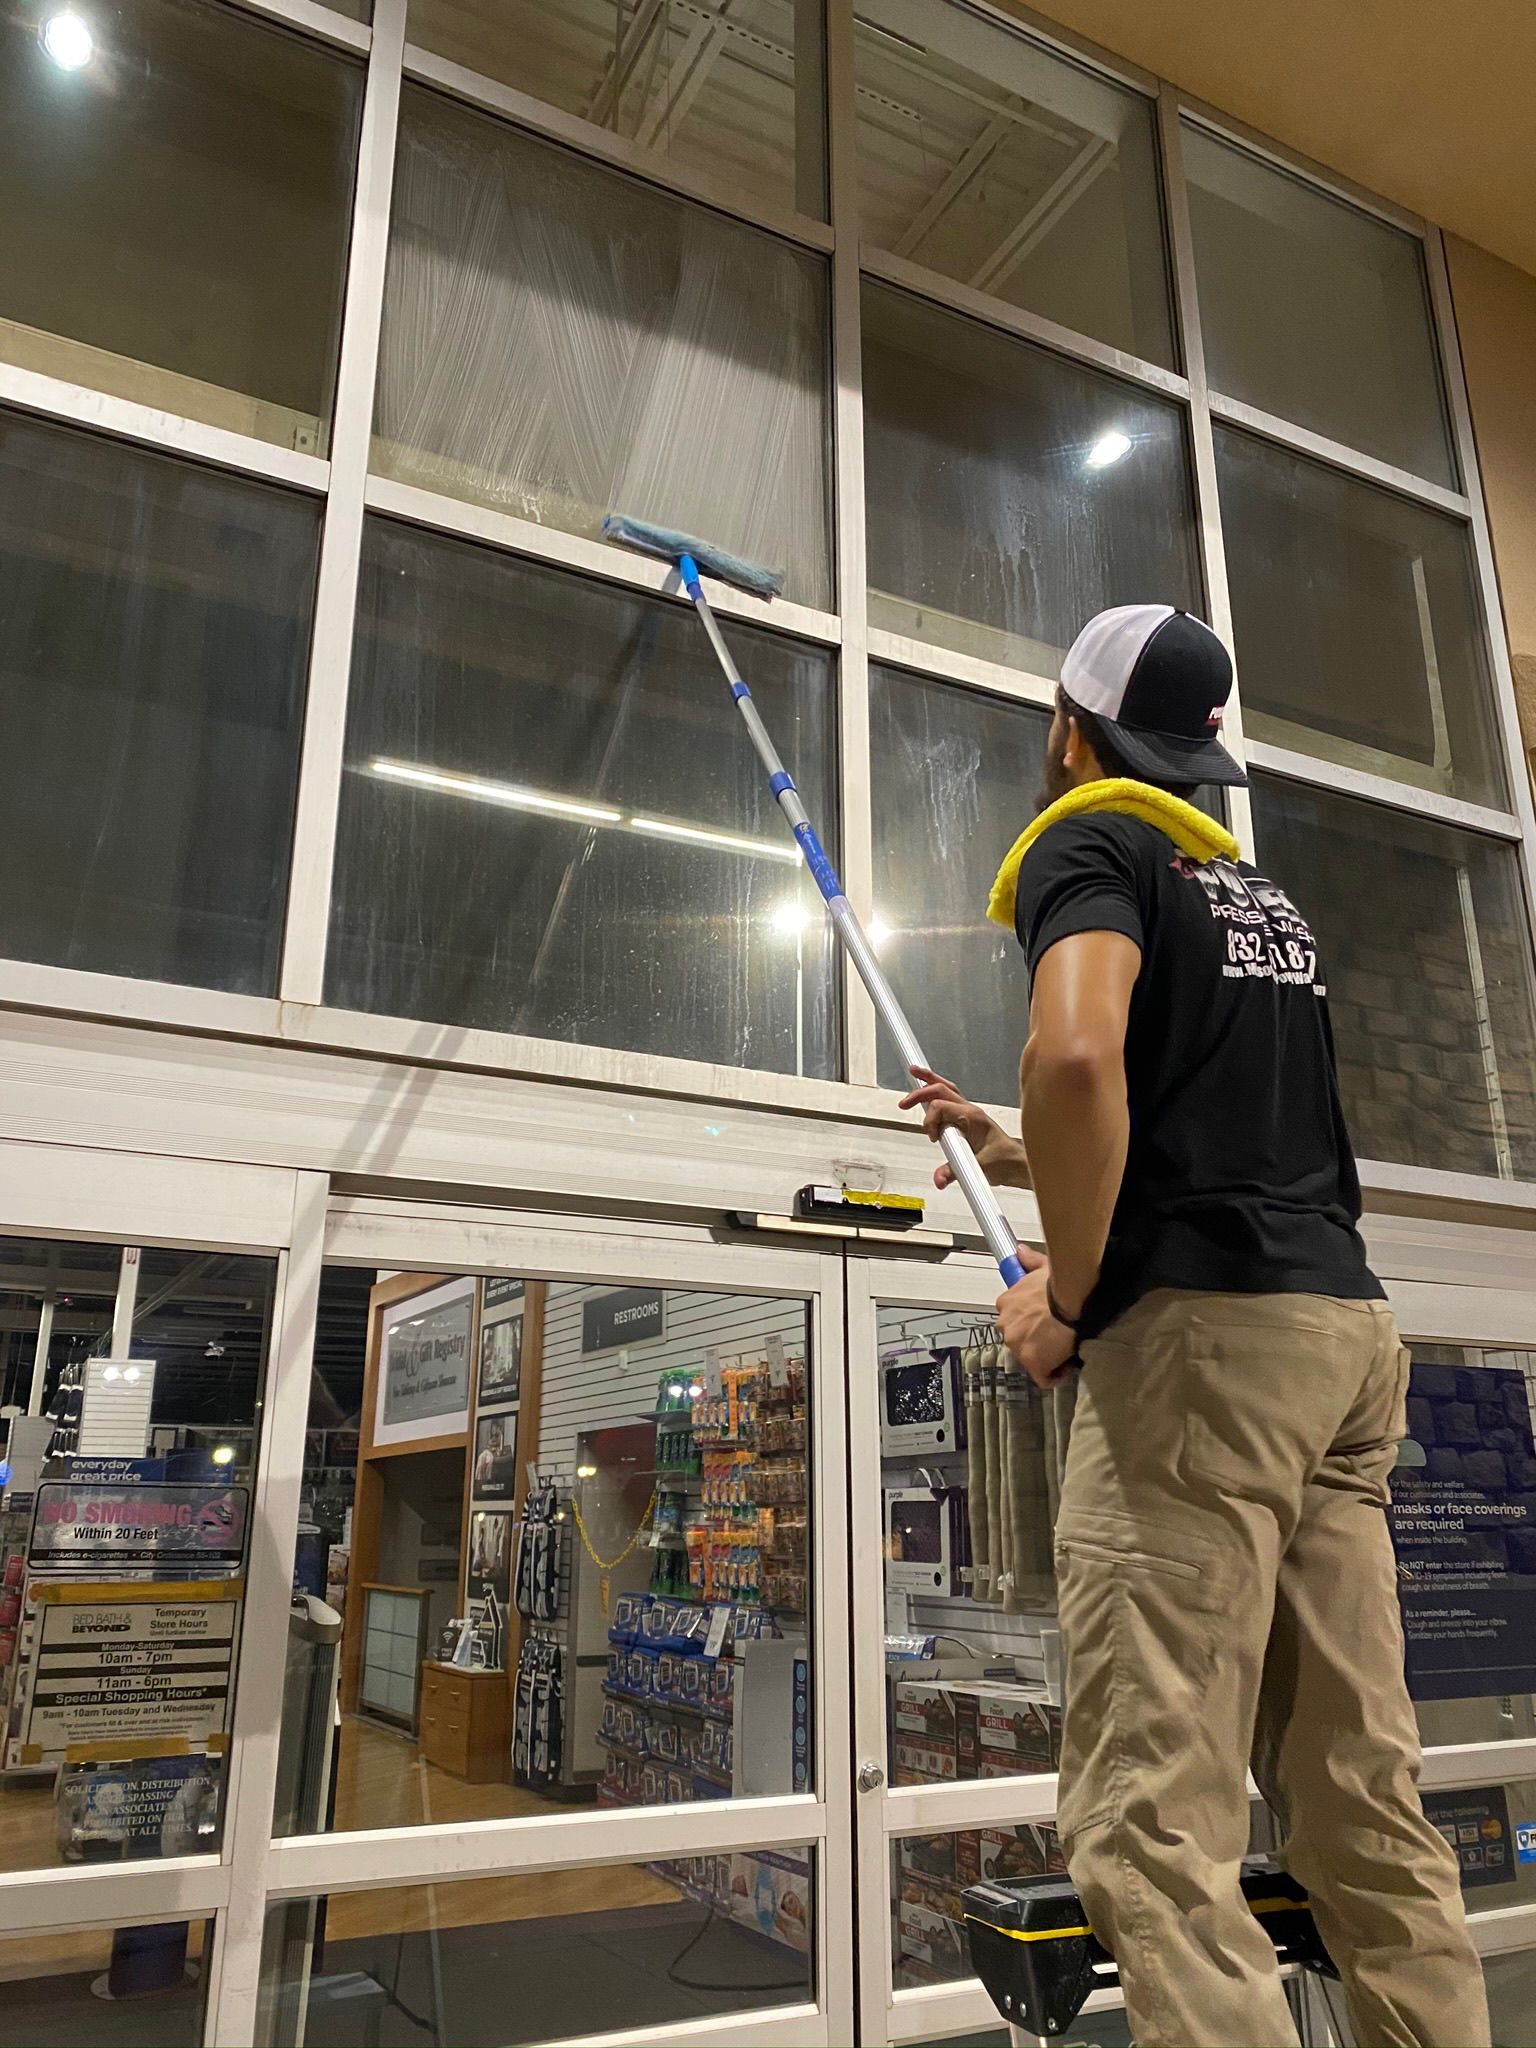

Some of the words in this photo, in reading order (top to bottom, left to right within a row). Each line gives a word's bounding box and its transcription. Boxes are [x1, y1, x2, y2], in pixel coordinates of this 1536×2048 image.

[1227, 928, 1266, 962] 832
[614, 1301, 659, 1325] RESTROOMS
[434, 1333, 466, 1362] Registry
[71, 1460, 132, 1471] everyday
[70, 1471, 108, 1481] great
[108, 1471, 141, 1481] price
[43, 1500, 78, 1524] NO
[85, 1502, 192, 1527] SMOKING
[1393, 1502, 1432, 1514] masks
[1433, 1505, 1445, 1514] or
[1447, 1502, 1472, 1515] face
[1474, 1502, 1527, 1518] coverings
[1395, 1519, 1414, 1530] are
[1416, 1518, 1464, 1532] required
[74, 1527, 112, 1540] Within
[115, 1527, 130, 1540] 20
[133, 1527, 158, 1540] Feet
[48, 1551, 81, 1559] Includes
[1409, 1560, 1425, 1569] NOT
[1425, 1560, 1442, 1569] enter
[72, 1613, 94, 1625] BED
[96, 1612, 122, 1624] BATH
[123, 1612, 132, 1624] &
[155, 1608, 206, 1618] Temporary
[71, 1624, 131, 1633] BEYOND
[150, 1620, 176, 1629] Store
[179, 1619, 208, 1629] Hours
[101, 1641, 175, 1651] Monday-Saturday
[98, 1652, 133, 1664] 10am
[145, 1651, 173, 1664] 7pm
[120, 1666, 152, 1675] Sunday
[97, 1678, 131, 1689] 11am
[144, 1676, 172, 1689] 6pm
[55, 1693, 100, 1705] Special
[105, 1688, 163, 1702] Shopping
[42, 1710, 64, 1719] 9am
[74, 1708, 99, 1717] 10am
[102, 1706, 141, 1717] Tuesday
[143, 1705, 160, 1714] and
[163, 1703, 216, 1712] Wednesday
[900, 1702, 920, 1714] GRILL
[985, 1717, 1009, 1729] GRILL
[142, 1777, 211, 1790] DISTRIBUTION
[147, 1814, 161, 1824] ON
[139, 1825, 158, 1836] ALL
[981, 1829, 1003, 1845] GRILL
[905, 1925, 926, 1941] GRILL
